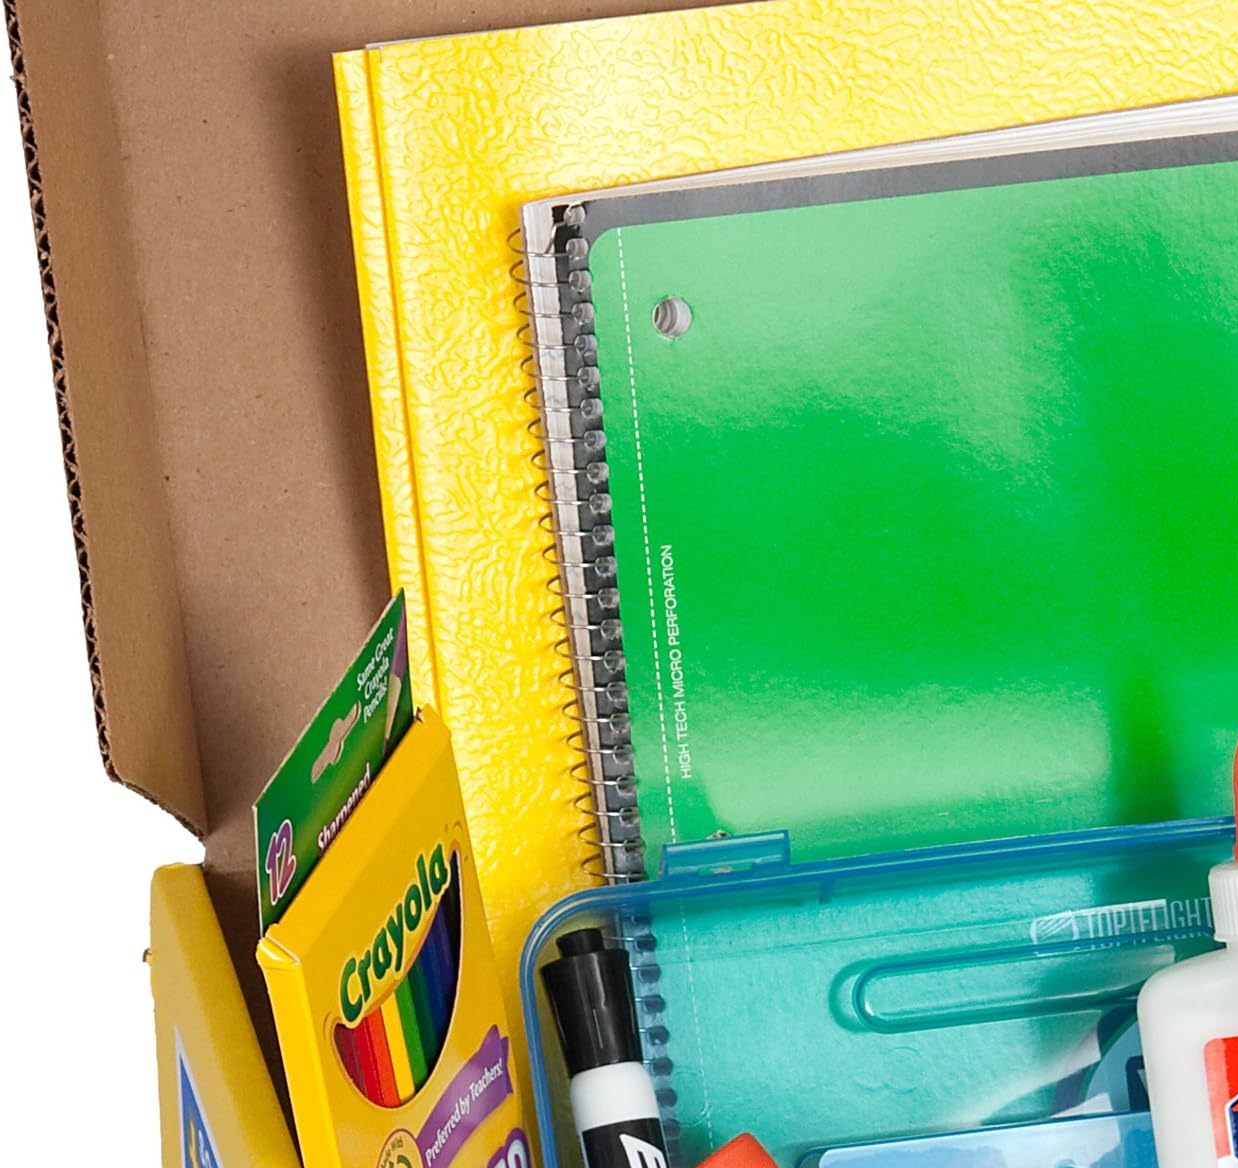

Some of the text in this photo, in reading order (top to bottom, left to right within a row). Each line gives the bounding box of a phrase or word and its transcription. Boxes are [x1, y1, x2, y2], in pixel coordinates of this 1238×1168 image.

[357, 627, 393, 691] Same Great
[365, 657, 389, 699] Crayola
[660, 545, 691, 780] HIGH TECH MICRO PERFORATION
[267, 819, 297, 905] 12
[341, 843, 448, 1022] Crayola
[425, 1057, 503, 1168] Preferred by Teachers!
